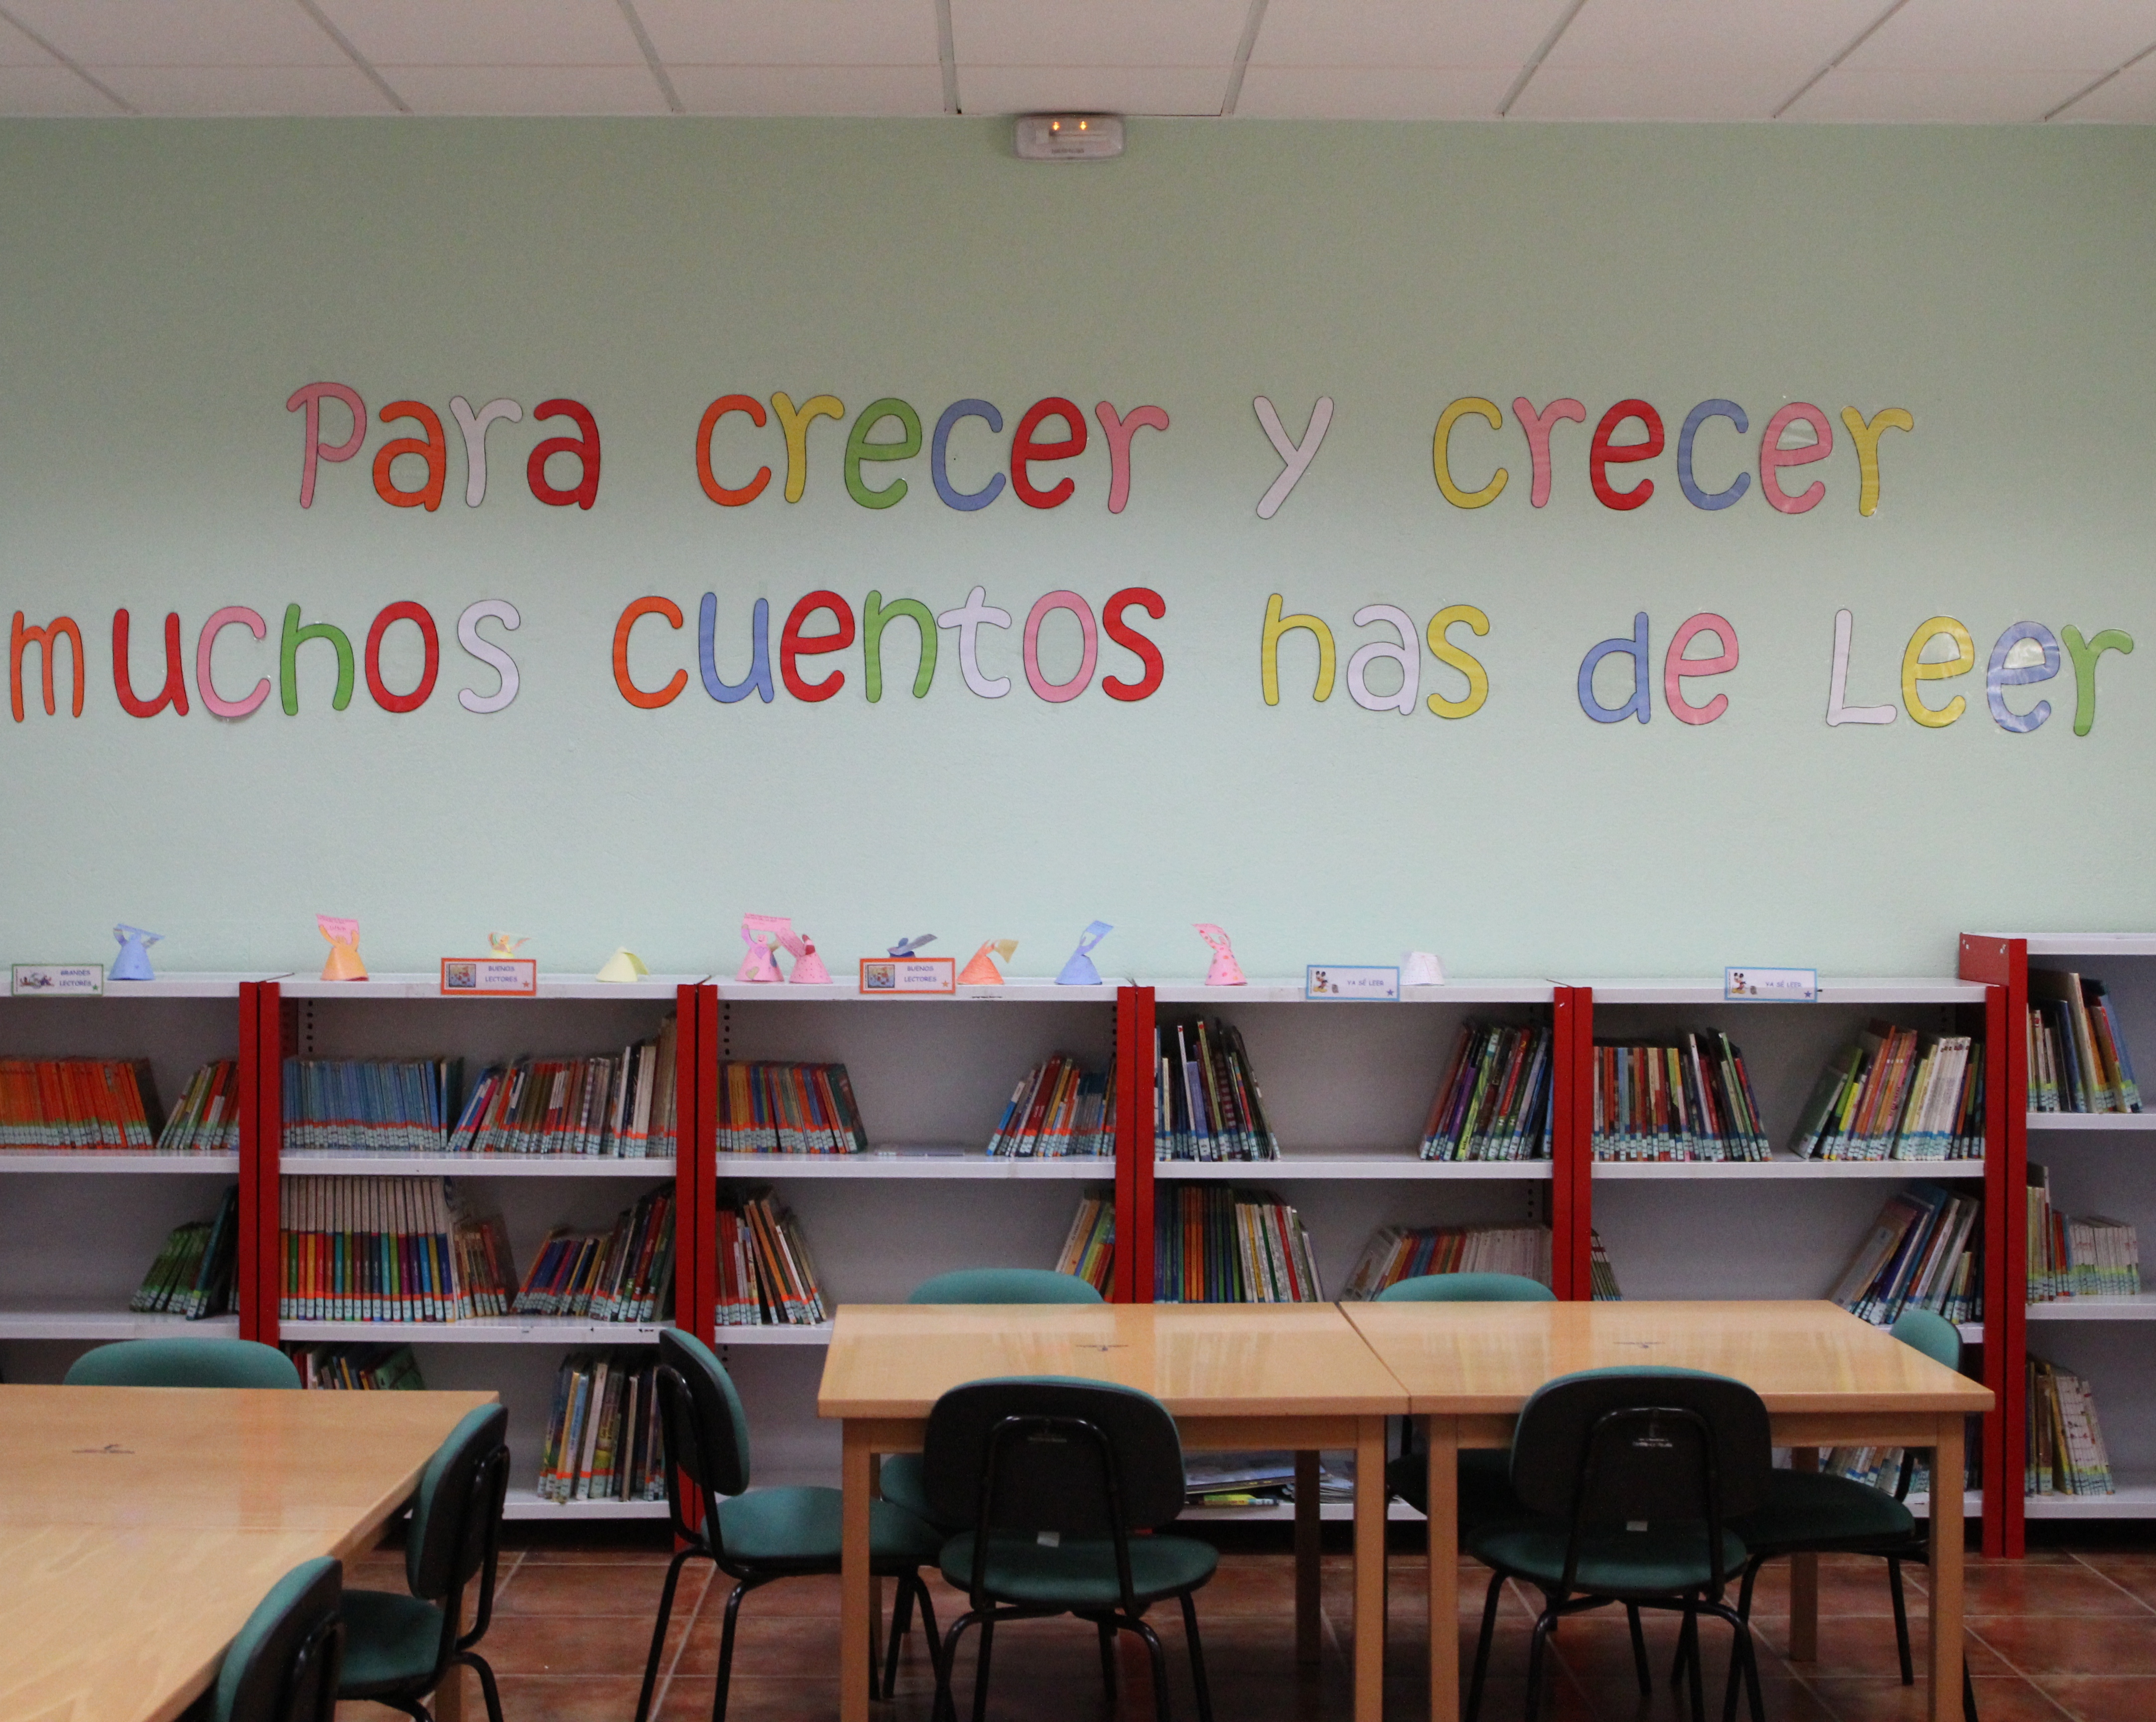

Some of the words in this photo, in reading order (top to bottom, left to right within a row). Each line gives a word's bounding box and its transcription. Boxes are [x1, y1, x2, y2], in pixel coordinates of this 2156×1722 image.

[286, 382, 600, 512] Para
[696, 391, 1169, 514] crecer
[1253, 396, 1334, 520] y
[1433, 397, 1914, 516] crecer
[10, 599, 521, 723] muchos
[612, 586, 1166, 709] cuentos
[1261, 593, 1490, 718] has
[1578, 611, 1739, 725] de
[1826, 608, 2134, 737] Leer
